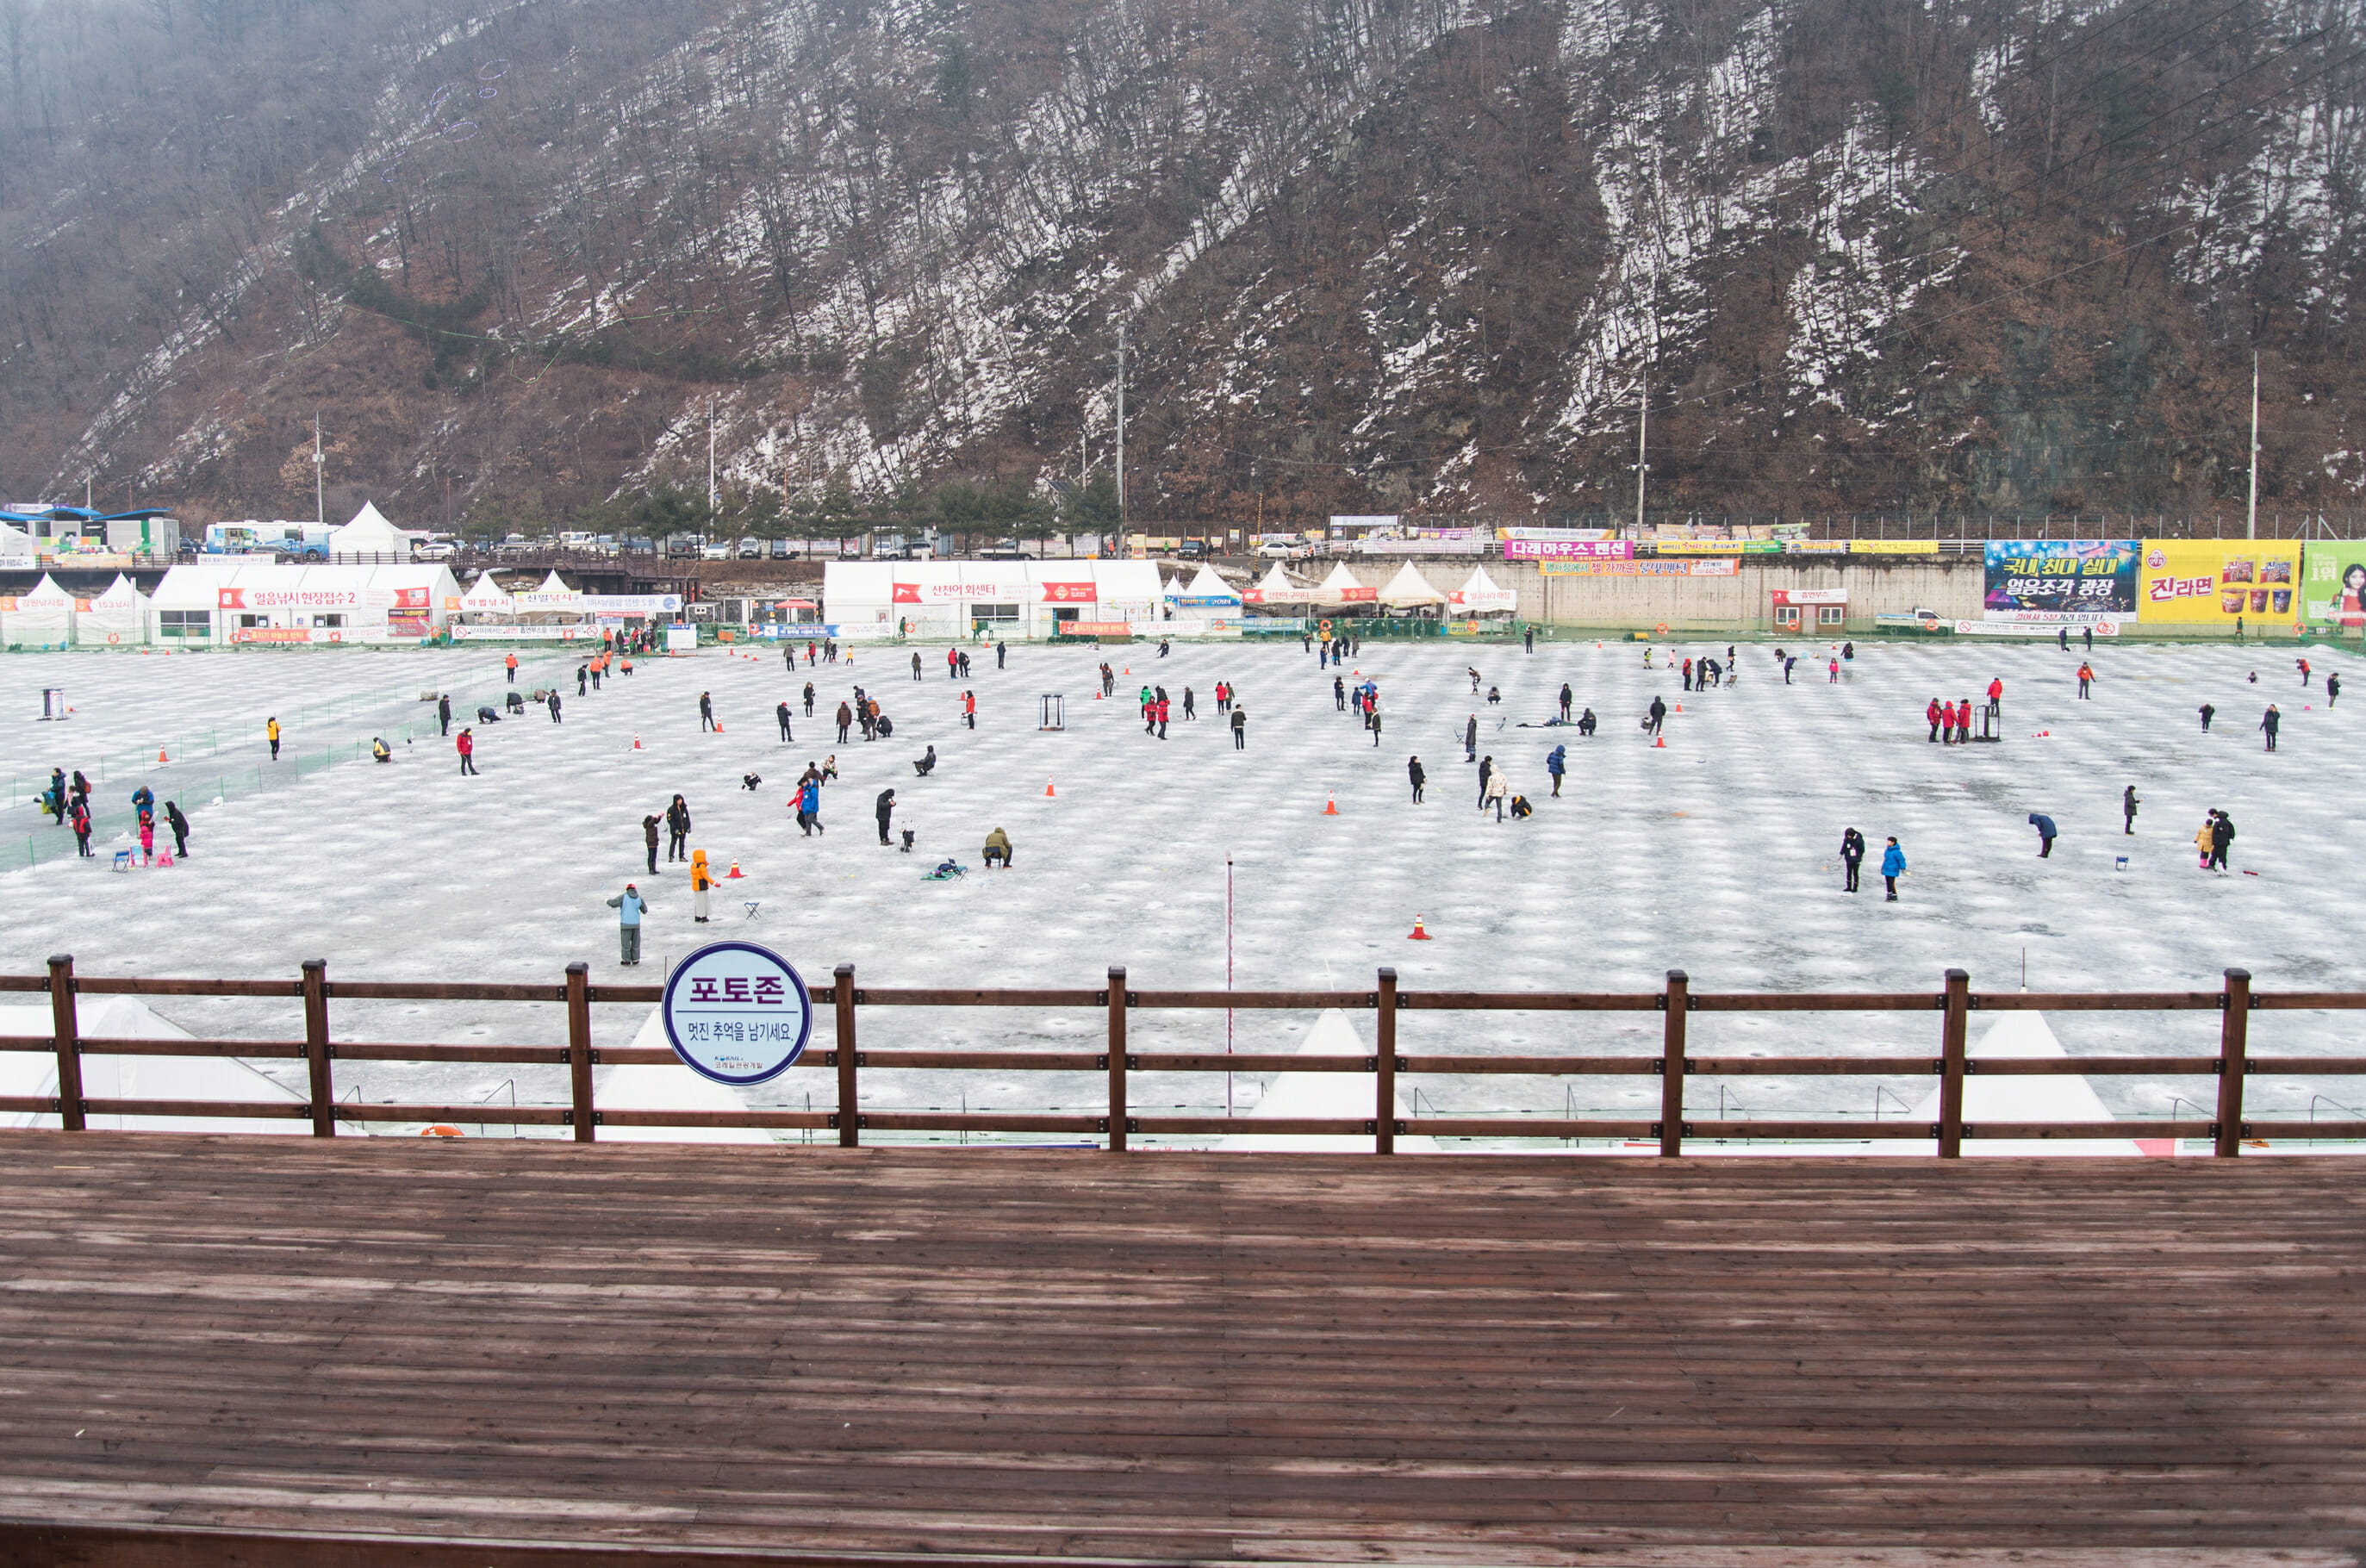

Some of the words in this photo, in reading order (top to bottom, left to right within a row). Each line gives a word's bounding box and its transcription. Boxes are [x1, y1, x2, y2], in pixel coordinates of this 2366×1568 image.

[1545, 563, 1589, 574] 행사장에서
[1591, 563, 1602, 574] 젤
[1605, 563, 1635, 574] 가까운
[2003, 557, 2039, 575] 국내
[2041, 557, 2078, 575] 최대
[2082, 557, 2119, 575] 실내
[2310, 566, 2338, 582] 1위
[931, 584, 962, 596] 산천어
[965, 584, 996, 595] 회센터
[1268, 591, 1288, 600] 산천어
[1288, 591, 1310, 600] 구이터
[2006, 578, 2075, 596] 얼음조각
[2078, 578, 2115, 596] 광장
[2149, 576, 2213, 601] 진라면
[254, 592, 299, 606] 얼음낚시
[302, 592, 346, 606] 현장접수
[348, 592, 356, 604] 2
[689, 976, 785, 1005] 포토존
[688, 1022, 709, 1042] 멋진
[713, 1022, 744, 1041] 추억을
[748, 1022, 794, 1042] 남기세요.
